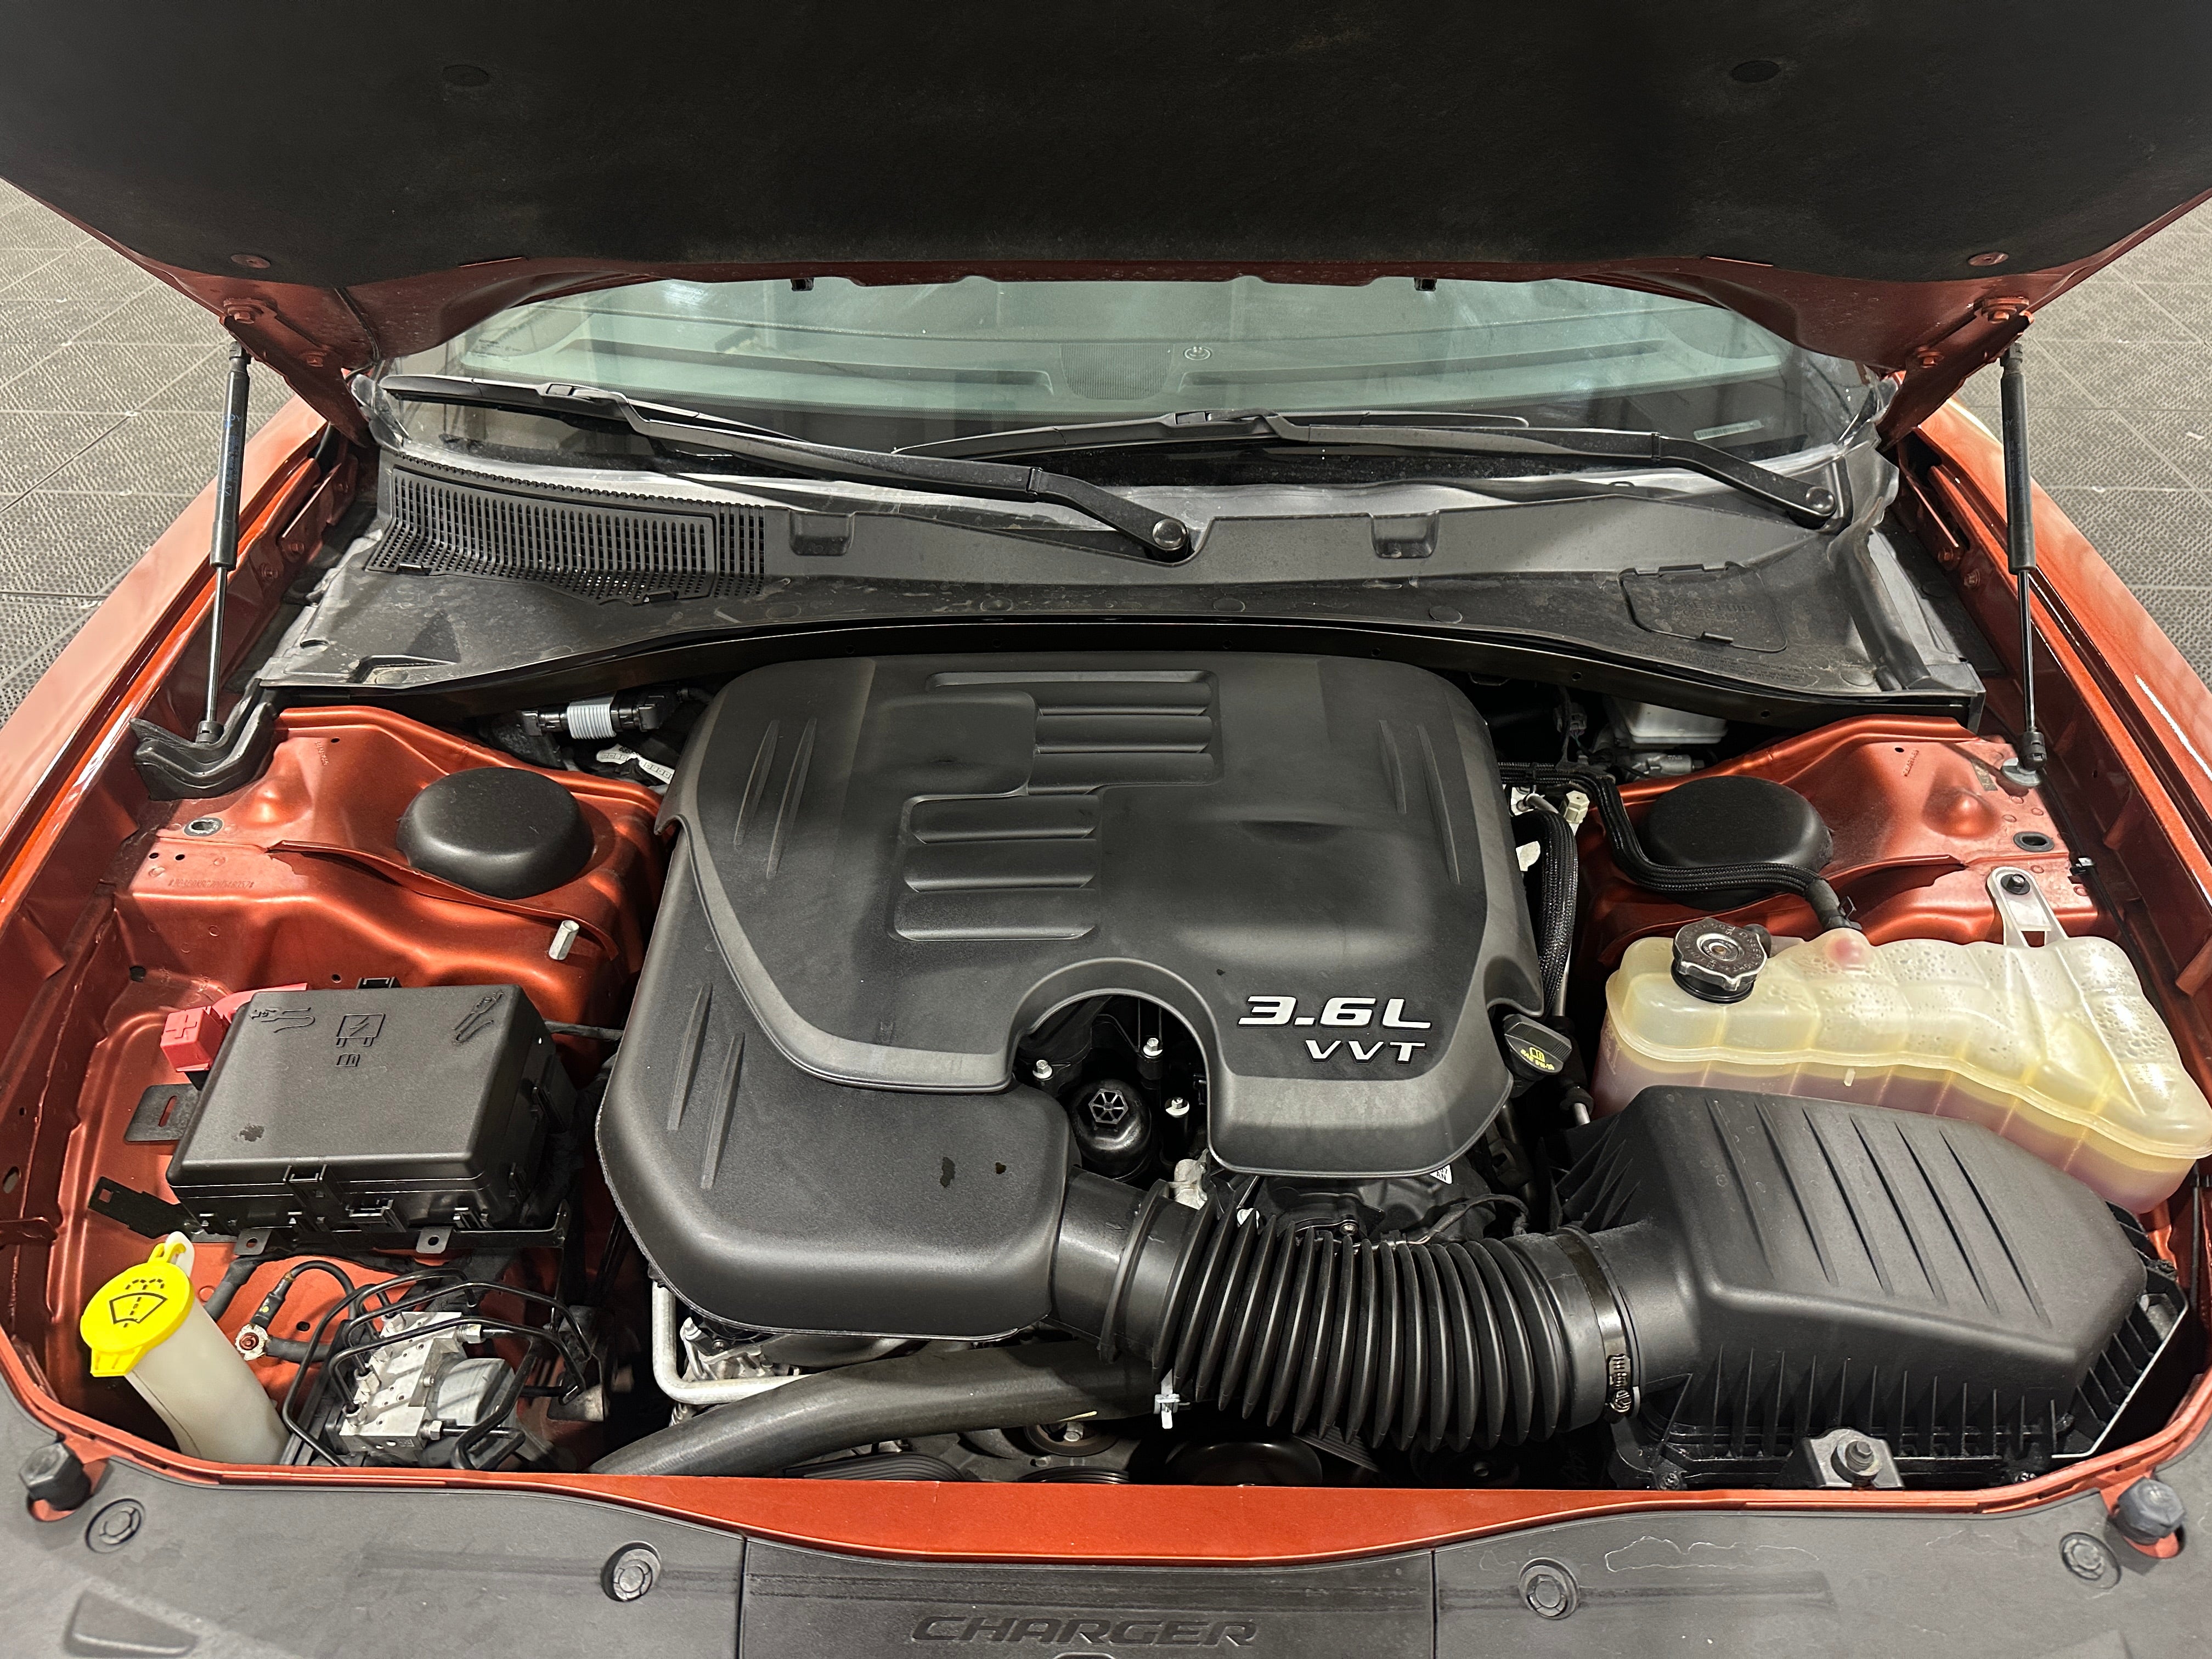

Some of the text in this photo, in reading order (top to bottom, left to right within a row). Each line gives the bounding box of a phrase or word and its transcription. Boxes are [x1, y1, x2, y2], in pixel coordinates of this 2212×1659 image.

[1238, 995, 1432, 1029] 3.6L
[1305, 1040, 1426, 1062] VVT
[911, 1616, 1258, 1647] CHARGER
